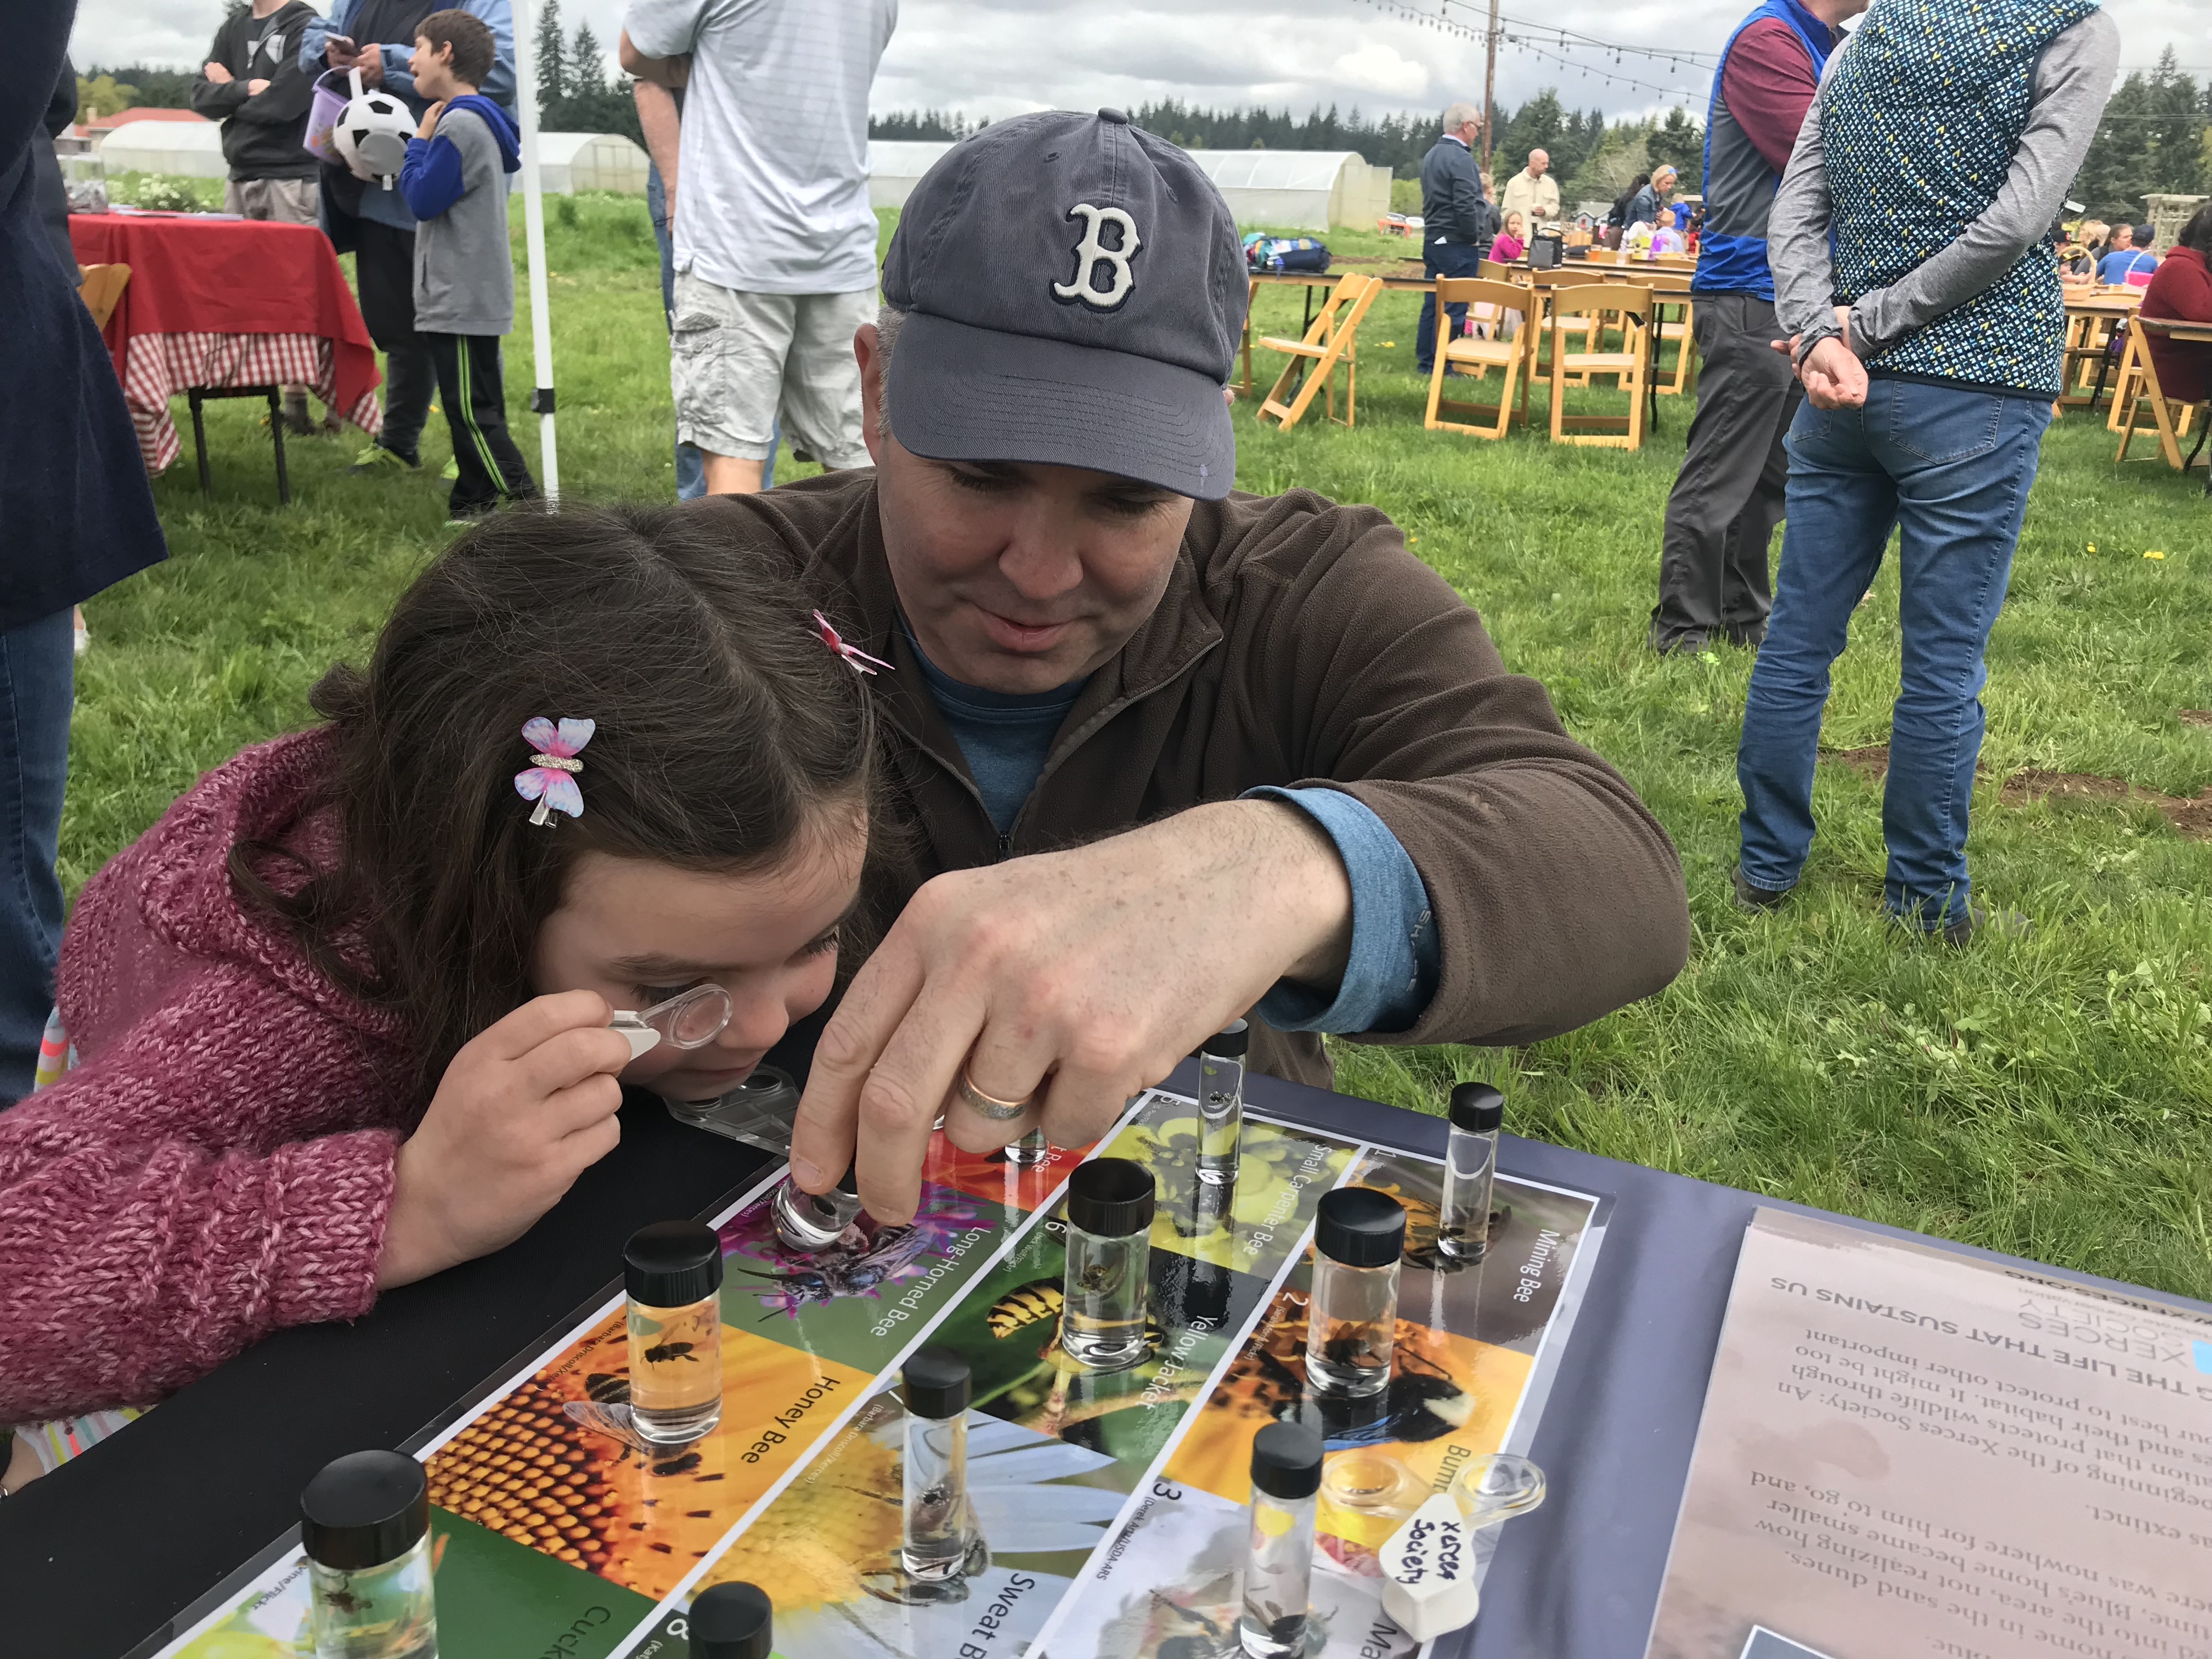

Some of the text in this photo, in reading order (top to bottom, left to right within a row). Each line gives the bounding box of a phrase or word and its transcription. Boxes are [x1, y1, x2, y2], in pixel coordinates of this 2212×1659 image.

[1051, 204, 1142, 311] B
[1031, 1153, 1062, 1172] Bee
[1374, 1149, 1397, 1158] 1
[1243, 1144, 1332, 1255] Small Carpenter Bee
[1045, 1222, 1067, 1233] 6
[1513, 1229, 1560, 1302] Mining Bee
[871, 1227, 991, 1336] Long-Horned Bee
[1770, 1277, 1808, 1296] US
[1282, 1292, 1308, 1306] 2
[1815, 1288, 1959, 1335] SUSTAINS
[2019, 1299, 2183, 1348] SOCIETY
[1803, 1329, 1918, 1370] important
[1965, 1328, 2046, 1359] THAT
[2017, 1312, 2188, 1368] XERCES
[1136, 1316, 1218, 1410] Yellow Jacket
[1795, 1345, 1832, 1365] too
[1838, 1357, 1865, 1376] be
[2052, 1348, 2117, 1378] LIFE
[1791, 1364, 1883, 1400] through
[1873, 1367, 1940, 1395] might
[1925, 1362, 1989, 1387] other
[2125, 1367, 2190, 1397] THE
[1778, 1381, 1812, 1401] An
[1948, 1387, 1966, 1403] It
[1995, 1380, 2080, 1411] protect
[741, 1376, 840, 1463] Honey Bee
[854, 1404, 884, 1431] (Barbara
[1819, 1393, 1912, 1431] Society:
[1890, 1391, 1979, 1426] wildlife
[1973, 1394, 2063, 1431] habitat.
[2087, 1406, 2111, 1421] to
[1919, 1421, 1999, 1457] Xerces
[1987, 1418, 2085, 1454] protects
[2071, 1421, 2129, 1447] their
[2121, 1414, 2168, 1439] best
[2007, 1446, 2046, 1468] the
[2094, 1447, 2142, 1472] that
[2138, 1438, 2185, 1459] and
[2049, 1459, 2079, 1475] of
[1153, 1483, 1182, 1500] 3
[1751, 1470, 1797, 1494] and
[1804, 1485, 1841, 1505] go,
[1134, 1497, 1156, 1521] (Derek
[1767, 1499, 1859, 1536] smaller
[1847, 1500, 1871, 1517] to
[2085, 1504, 2181, 1541] extinct.
[1754, 1520, 1809, 1548] how
[1881, 1509, 1932, 1538] him
[1867, 1529, 1966, 1573] became
[1938, 1528, 1976, 1551] for
[1785, 1550, 1867, 1588] dunes.
[1816, 1533, 1928, 1583] realizing
[1984, 1540, 2098, 1583] nowhere
[1937, 1575, 1980, 1598] not
[1974, 1562, 2049, 1598] home
[2108, 1576, 2156, 1600] was
[972, 1573, 1035, 1640] Sweat
[1877, 1580, 1938, 1609] sand
[1946, 1603, 1989, 1627] the
[1999, 1618, 2025, 1640] in
[2062, 1613, 2104, 1637] the
[2114, 1628, 2168, 1656] into
